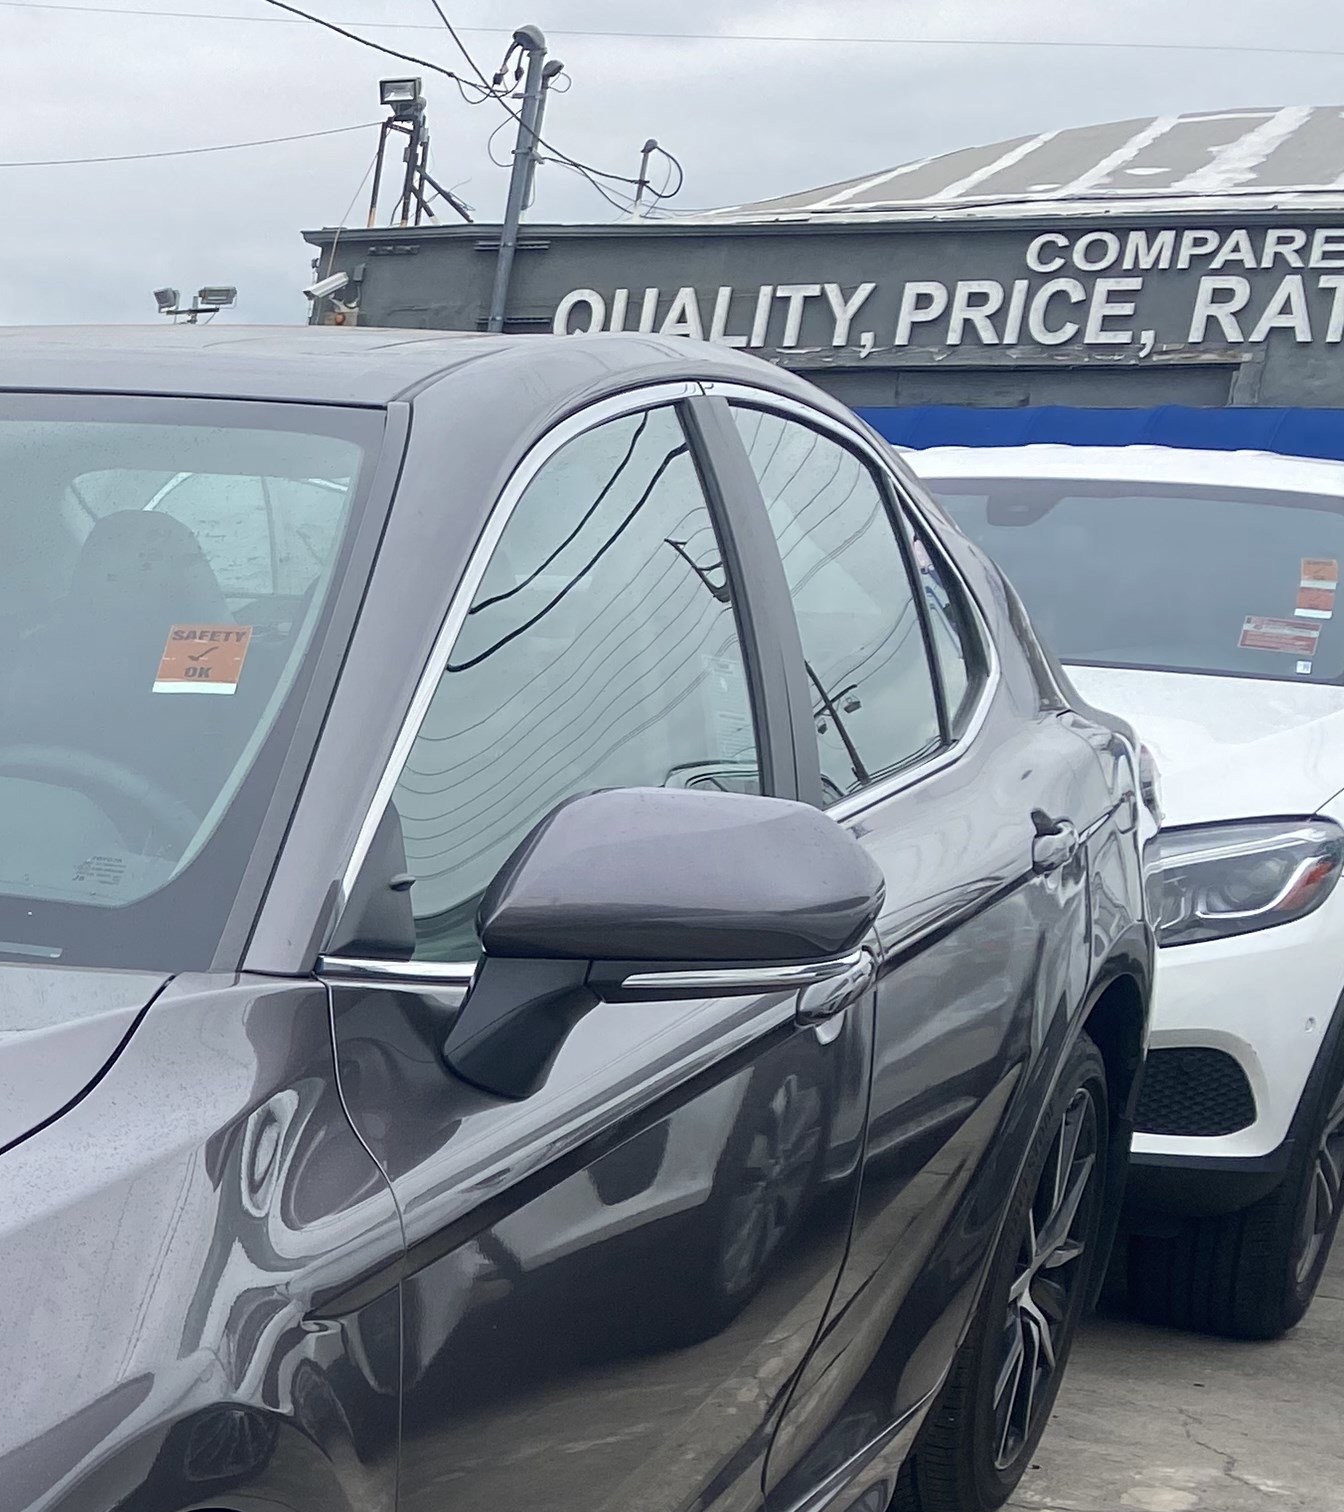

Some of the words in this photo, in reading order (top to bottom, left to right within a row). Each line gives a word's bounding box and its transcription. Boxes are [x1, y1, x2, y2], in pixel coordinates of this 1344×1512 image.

[1026, 228, 1344, 273] COMPARE
[553, 283, 876, 359] QUALITY,
[894, 277, 1155, 358] PRICE,
[172, 630, 246, 642] SAFETY
[184, 667, 212, 678] OK
